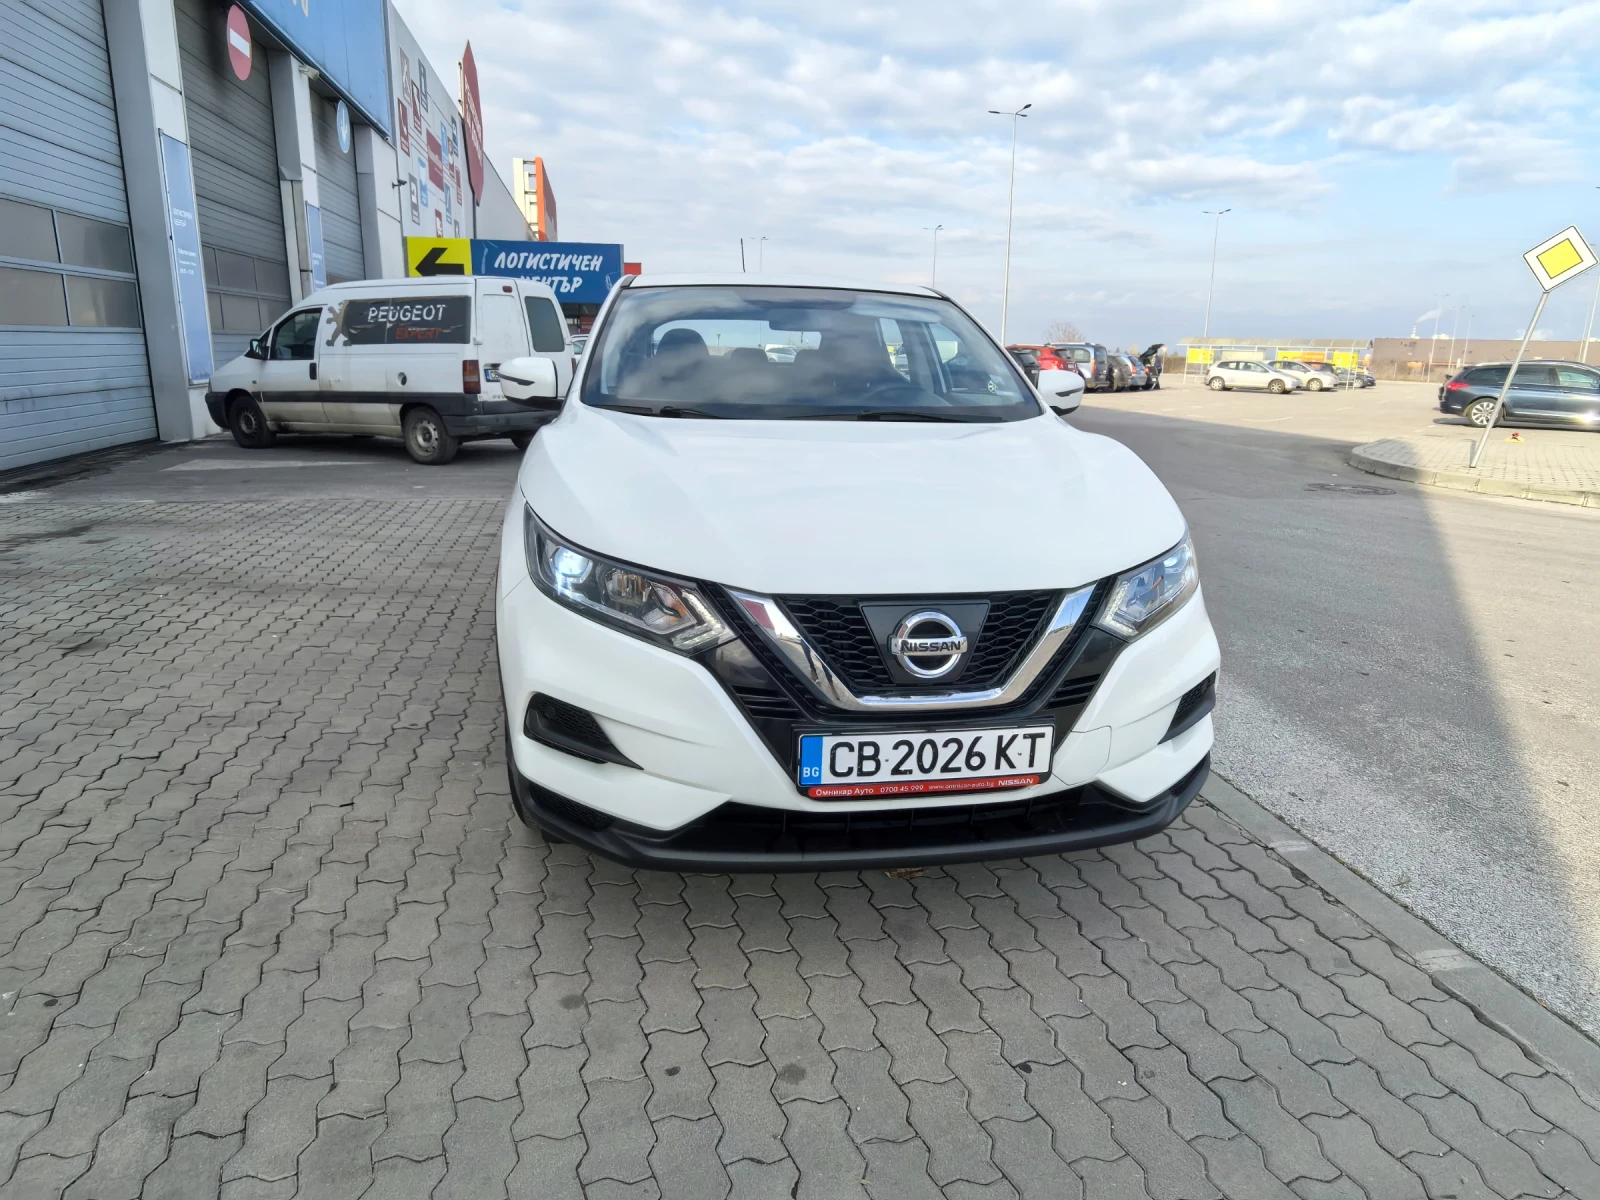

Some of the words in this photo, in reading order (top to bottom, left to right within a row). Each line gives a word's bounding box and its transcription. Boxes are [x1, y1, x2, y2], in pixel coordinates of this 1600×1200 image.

[494, 251, 603, 272] ЛОГИСТИЧЕН
[368, 304, 446, 323] PEUGEOT
[395, 327, 443, 340] EXPERT
[901, 640, 961, 653] NISSAN
[829, 741, 881, 777] CB
[890, 736, 986, 775] 2026
[995, 733, 1046, 770] KT
[803, 767, 819, 778] BG
[815, 788, 852, 796] Омникар
[854, 788, 874, 797] Ауто
[998, 778, 1034, 786] NISSAN
